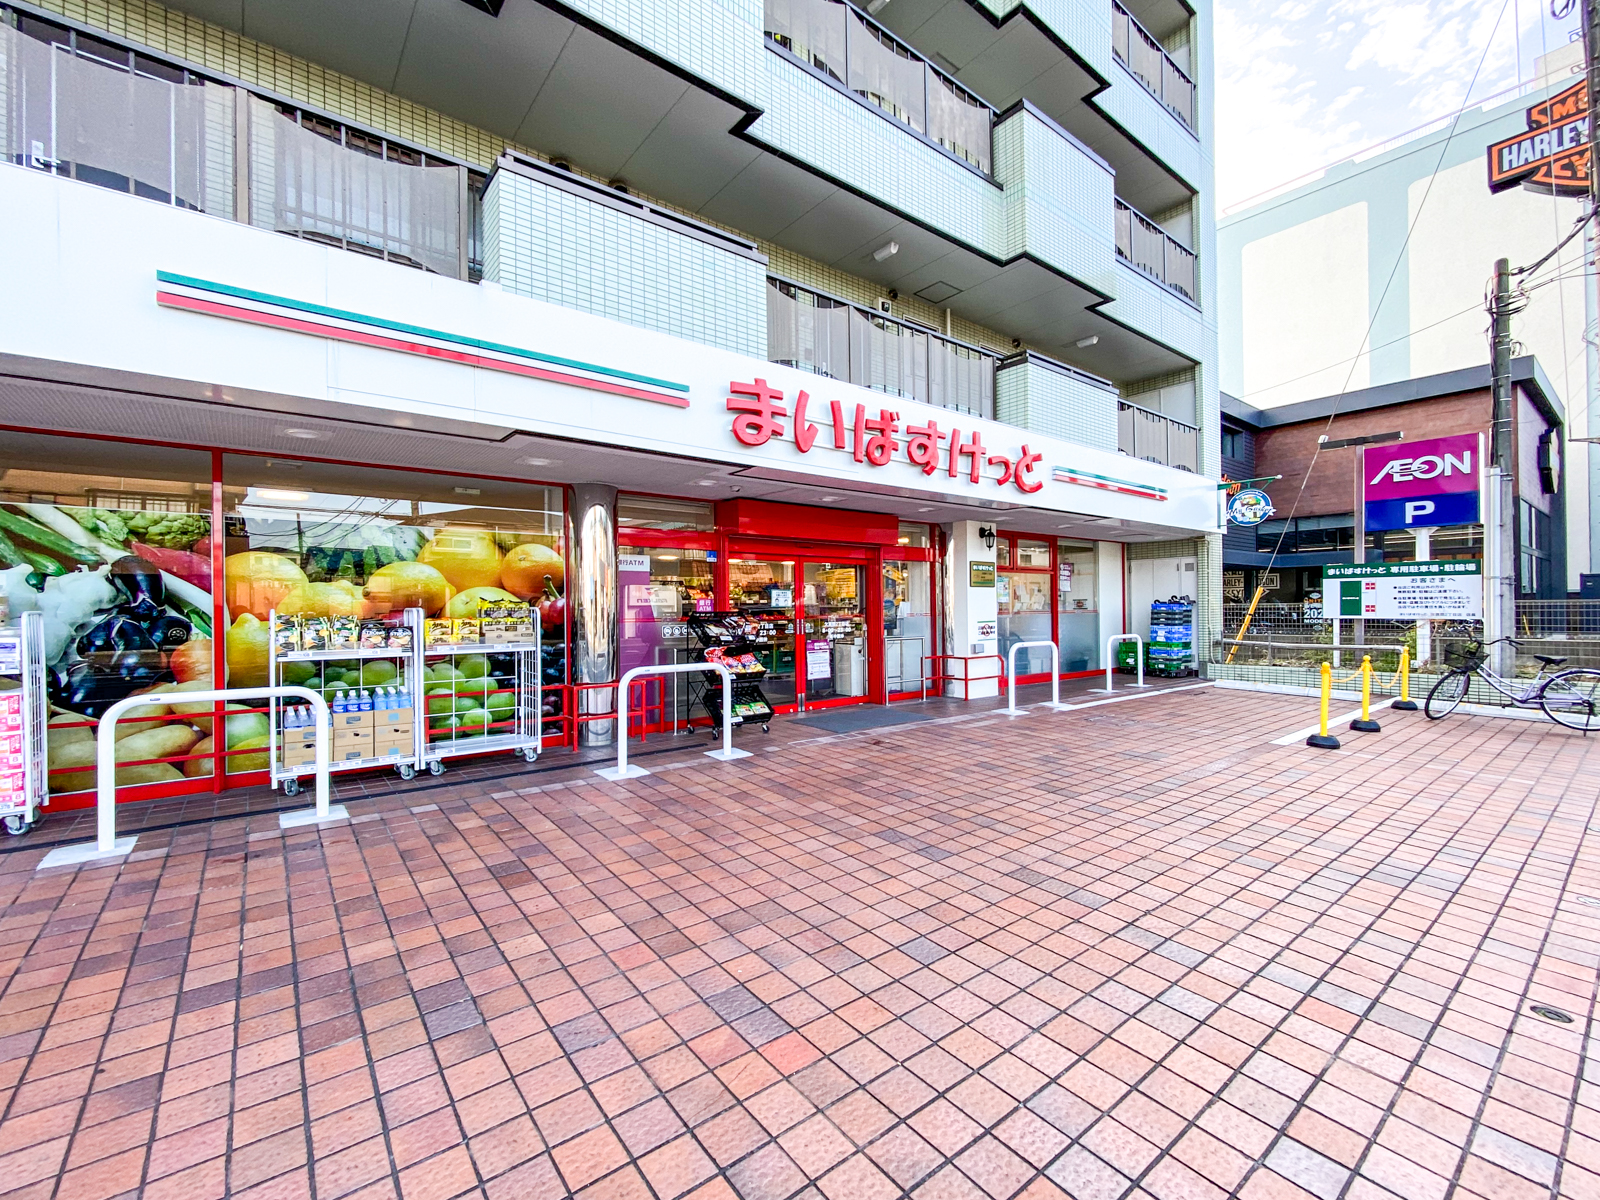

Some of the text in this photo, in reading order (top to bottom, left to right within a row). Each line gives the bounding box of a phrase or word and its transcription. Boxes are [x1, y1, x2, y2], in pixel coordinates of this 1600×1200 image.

[726, 378, 1043, 493] まいばすけっと
[1405, 501, 1435, 524] P
[1327, 563, 1477, 576] まいばすけっと 専用駐車場・駐輪場
